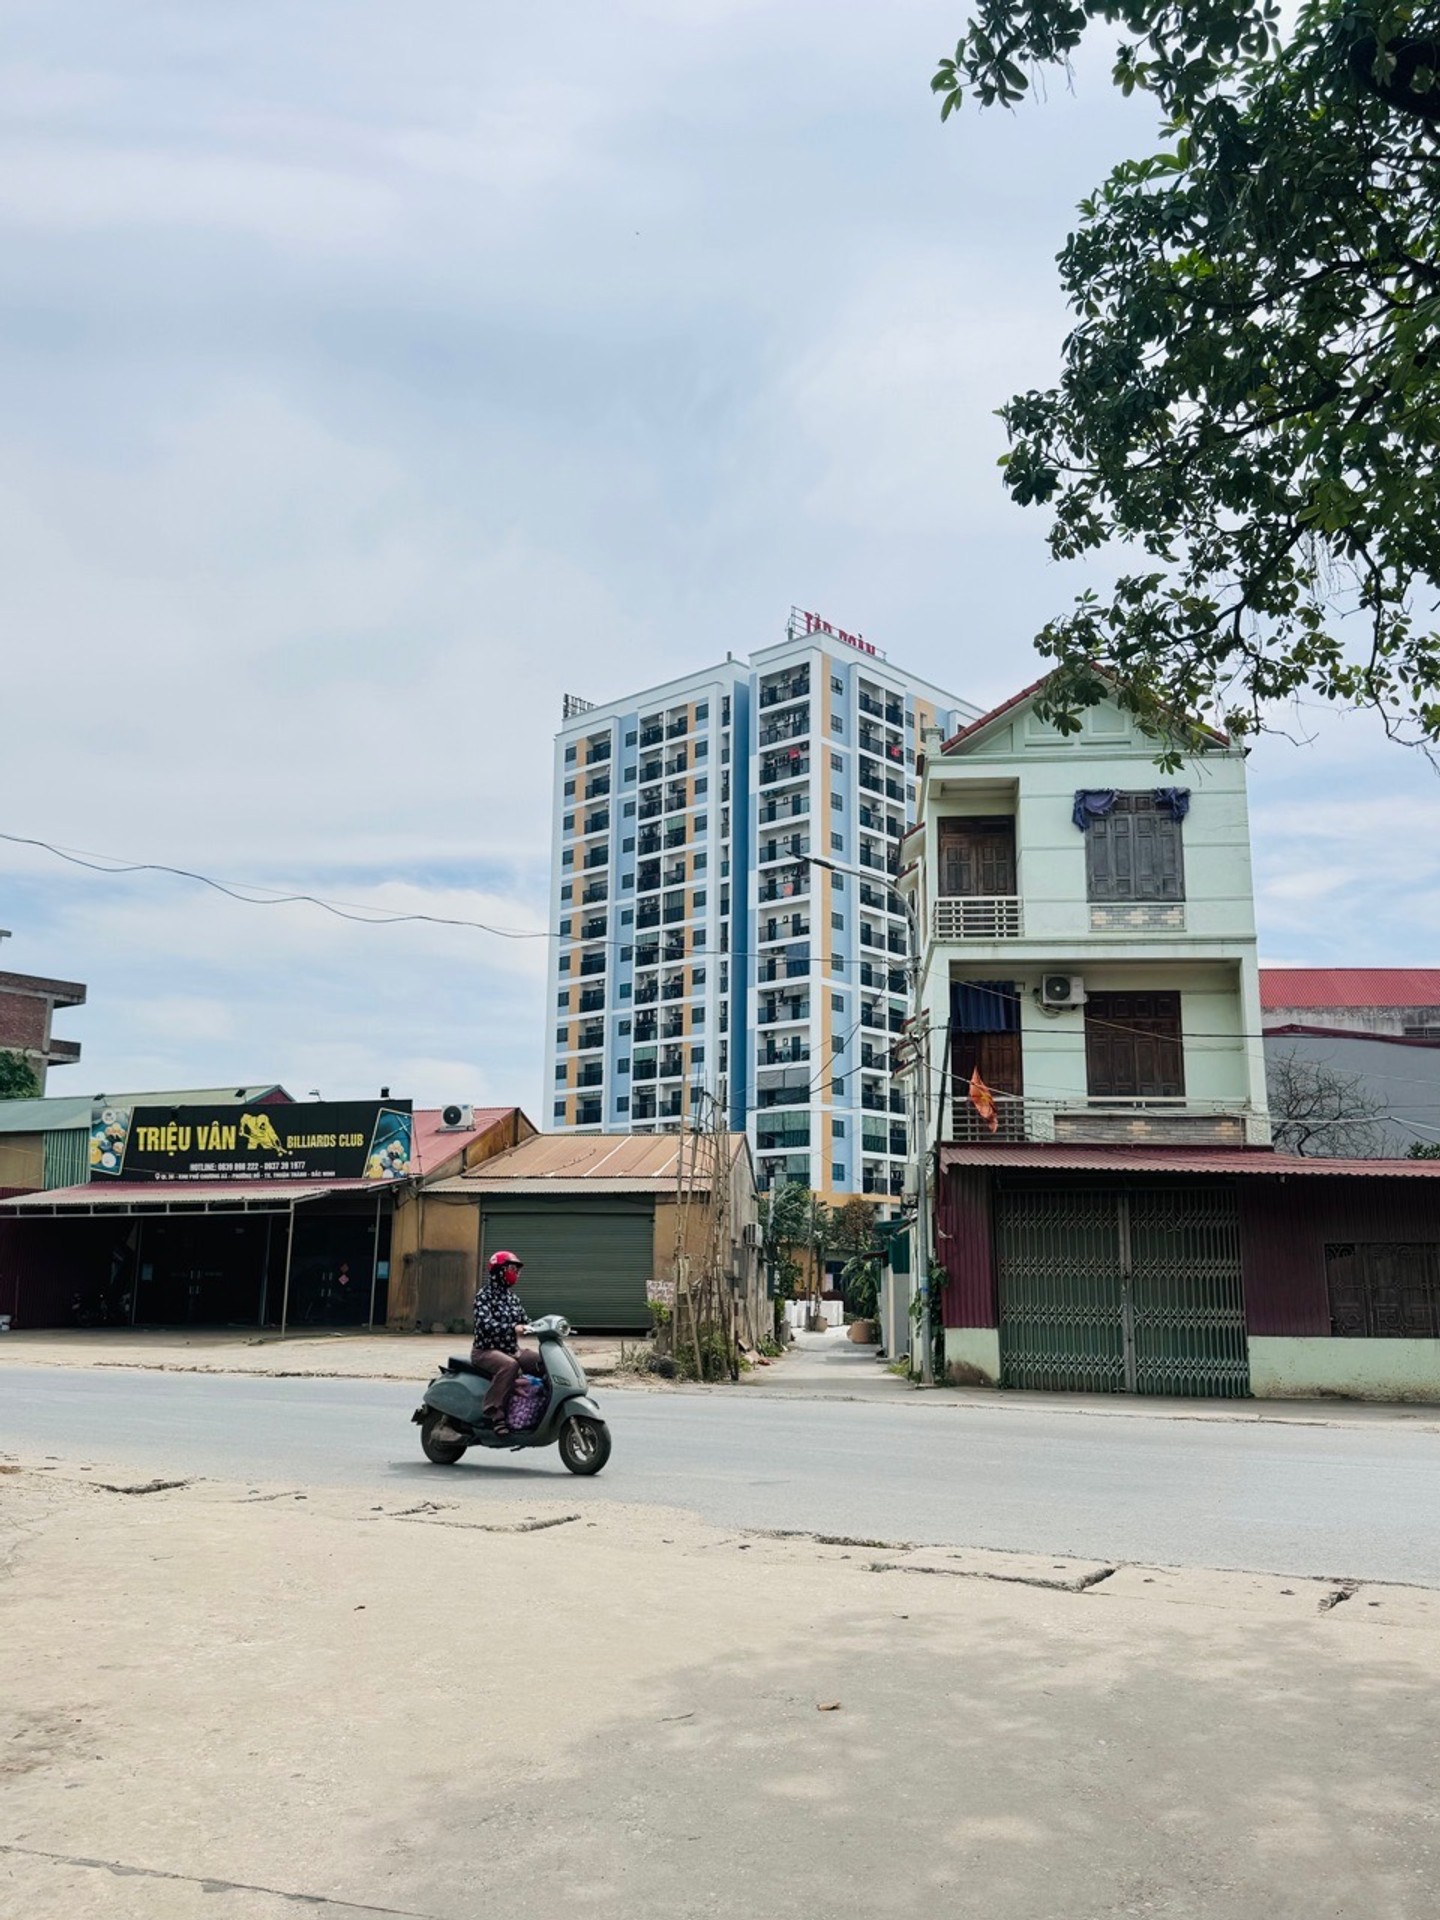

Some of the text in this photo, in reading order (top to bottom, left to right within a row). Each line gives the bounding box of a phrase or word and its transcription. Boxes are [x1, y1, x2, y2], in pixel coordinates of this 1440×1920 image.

[136, 1120, 236, 1157] TRIỆU VÂN
[287, 1133, 364, 1149] BILLIARDS CLUB
